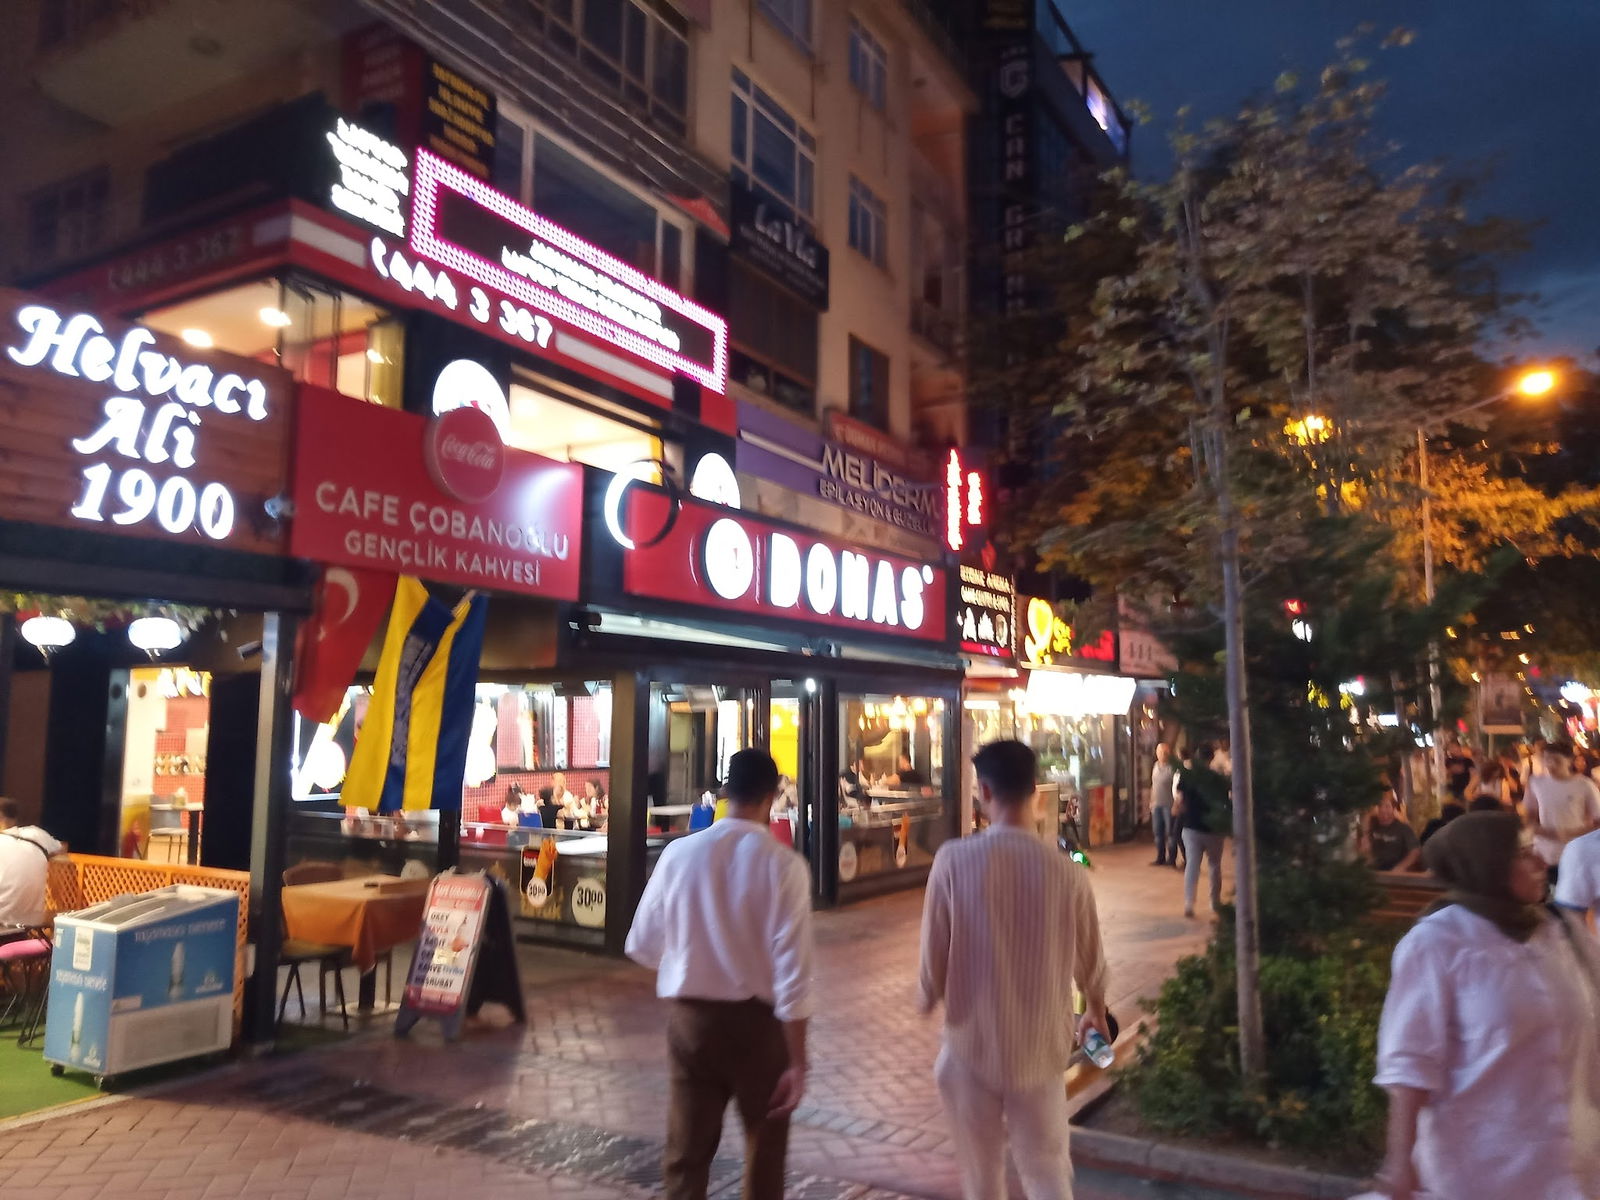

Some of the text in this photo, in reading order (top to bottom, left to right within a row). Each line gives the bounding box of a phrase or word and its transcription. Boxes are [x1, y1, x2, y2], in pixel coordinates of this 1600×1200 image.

[469, 287, 490, 323] 3
[73, 397, 201, 468] Ali
[71, 462, 234, 540] 1900
[315, 481, 400, 526] CAFE
[345, 530, 541, 586] GENÇLİK KAHVESİ
